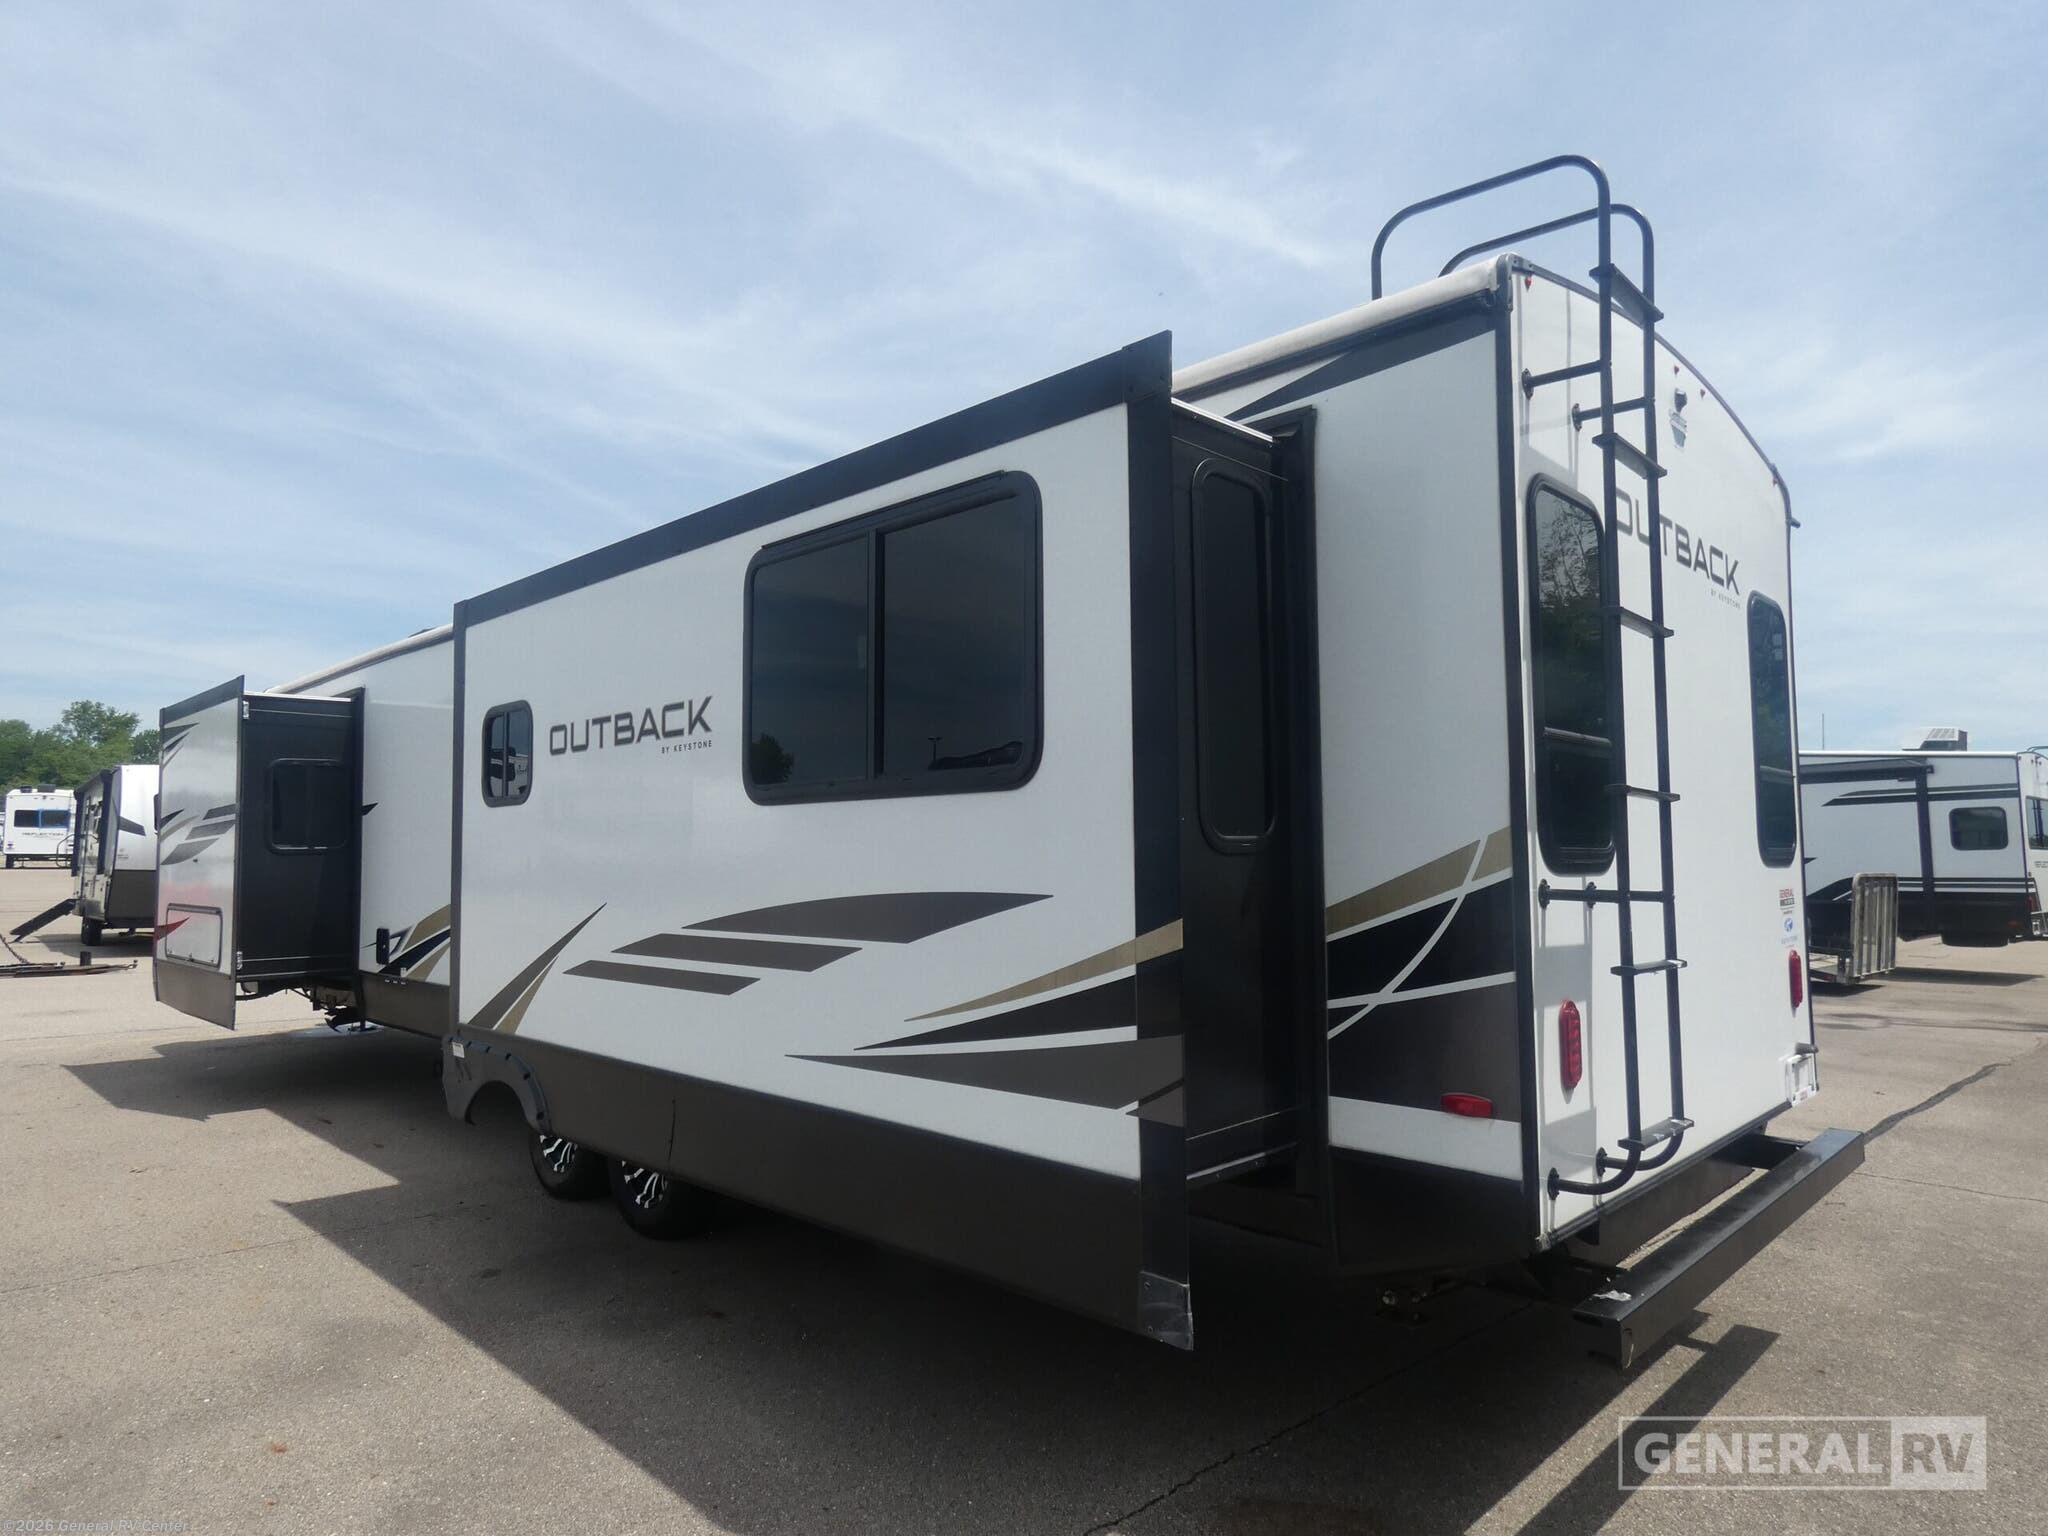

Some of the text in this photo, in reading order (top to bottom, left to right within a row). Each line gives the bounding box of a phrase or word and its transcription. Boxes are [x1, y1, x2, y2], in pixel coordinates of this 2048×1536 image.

[550, 696, 712, 755] OUTBACK
[661, 740, 712, 754] BY KEYSTONE
